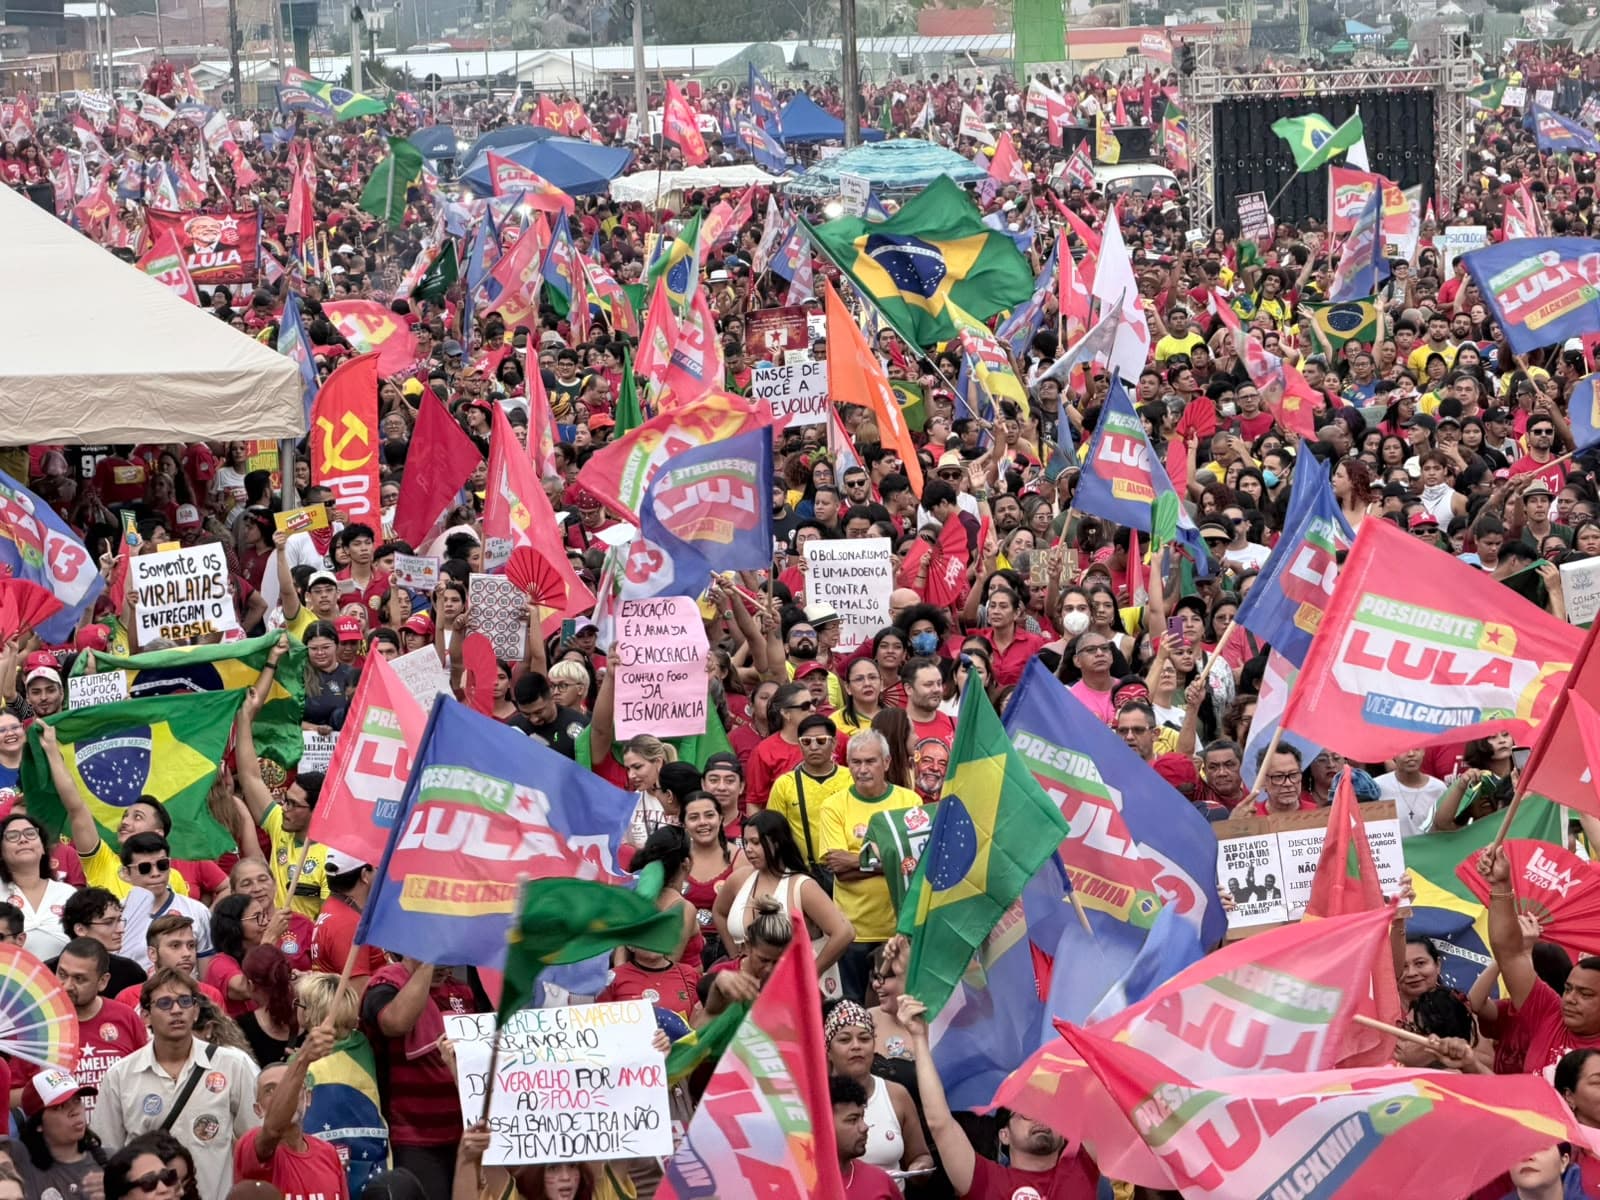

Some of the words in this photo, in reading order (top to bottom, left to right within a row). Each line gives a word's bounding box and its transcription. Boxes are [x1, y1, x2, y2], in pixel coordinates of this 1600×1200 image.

[1383, 187, 1404, 208] 13
[188, 249, 241, 269] LULA
[756, 366, 793, 381] NASCE
[802, 363, 820, 376] DE
[756, 379, 790, 398] VOCÊ
[799, 380, 810, 392] A
[48, 538, 86, 583] 13
[810, 550, 817, 560] O
[819, 549, 889, 560] BOLSONARISMO
[139, 553, 197, 579] Somente
[813, 565, 820, 578] É
[822, 567, 850, 578] UMA
[851, 567, 888, 577] DOENÇA
[139, 573, 225, 607] VIRALATAS
[825, 583, 868, 595] CONTRA
[142, 604, 204, 628] ENTREGAM
[212, 603, 222, 618] O
[621, 599, 676, 620] EDUCAÇÃO
[840, 600, 866, 610] MAL
[625, 619, 631, 637] É
[634, 625, 641, 636] A
[644, 624, 669, 636] ARMA
[859, 616, 885, 625] UMA
[1359, 597, 1477, 640] PRESIDENTE
[160, 621, 217, 639] BRASIL
[620, 642, 700, 666] DEMOCRACIA
[1343, 629, 1513, 688] LULA
[70, 679, 78, 688] A
[80, 672, 120, 686] FUMAÇA
[622, 672, 655, 684] CONTRA
[656, 673, 664, 682] O
[667, 670, 688, 682] FOGO
[622, 700, 704, 722] IGNORÂNCIA
[1366, 694, 1392, 716] VICE
[1391, 700, 1475, 726] ALCKMIN
[397, 807, 566, 861] LULA
[1288, 837, 1326, 848] DISCURS
[1224, 844, 1238, 853] SEU
[1225, 850, 1255, 861] APOIA
[1256, 849, 1270, 858] UM
[1292, 849, 1304, 857] DE
[1298, 862, 1317, 873] NÃO
[1526, 847, 1582, 898] LULA
[1523, 870, 1549, 889] 2026
[452, 1016, 491, 1041] DE
[556, 1009, 567, 1030] E
[569, 1003, 642, 1029] AMARELO
[526, 1033, 574, 1049] AMOR
[576, 1028, 599, 1048] AO
[497, 1068, 570, 1093] VERMELHO
[575, 1068, 615, 1090] POR
[618, 1065, 665, 1088] AMOR
[517, 1091, 538, 1110] AO
[551, 1089, 591, 1108] POVO
[525, 1112, 619, 1133] BANDEIRA
[624, 1105, 659, 1130] NÃO
[511, 1131, 556, 1159] TEM
[559, 1132, 620, 1158] DONO!!
